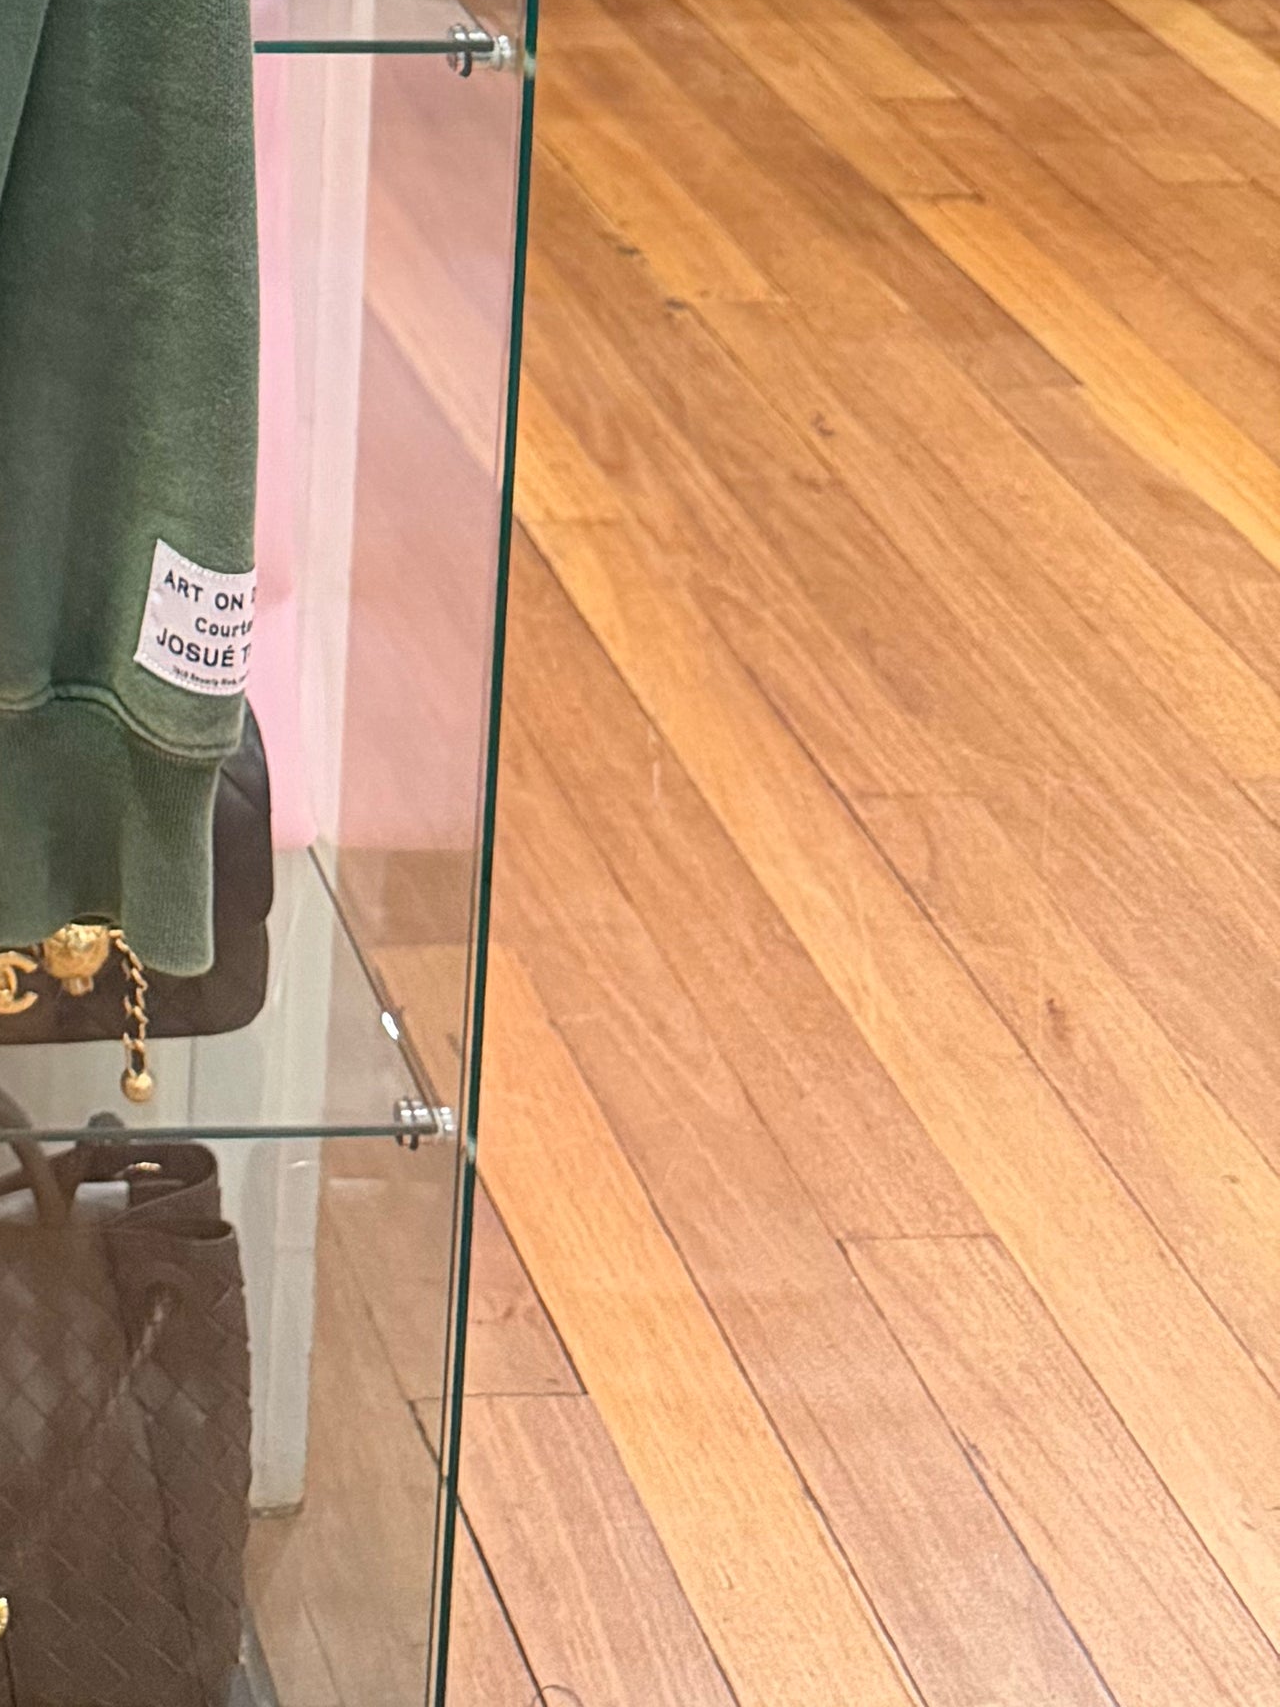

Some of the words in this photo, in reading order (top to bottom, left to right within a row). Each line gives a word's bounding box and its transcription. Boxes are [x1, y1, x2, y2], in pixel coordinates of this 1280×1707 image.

[164, 569, 203, 603] ART
[215, 593, 244, 610] ON
[156, 627, 234, 668] JOSUÉ
